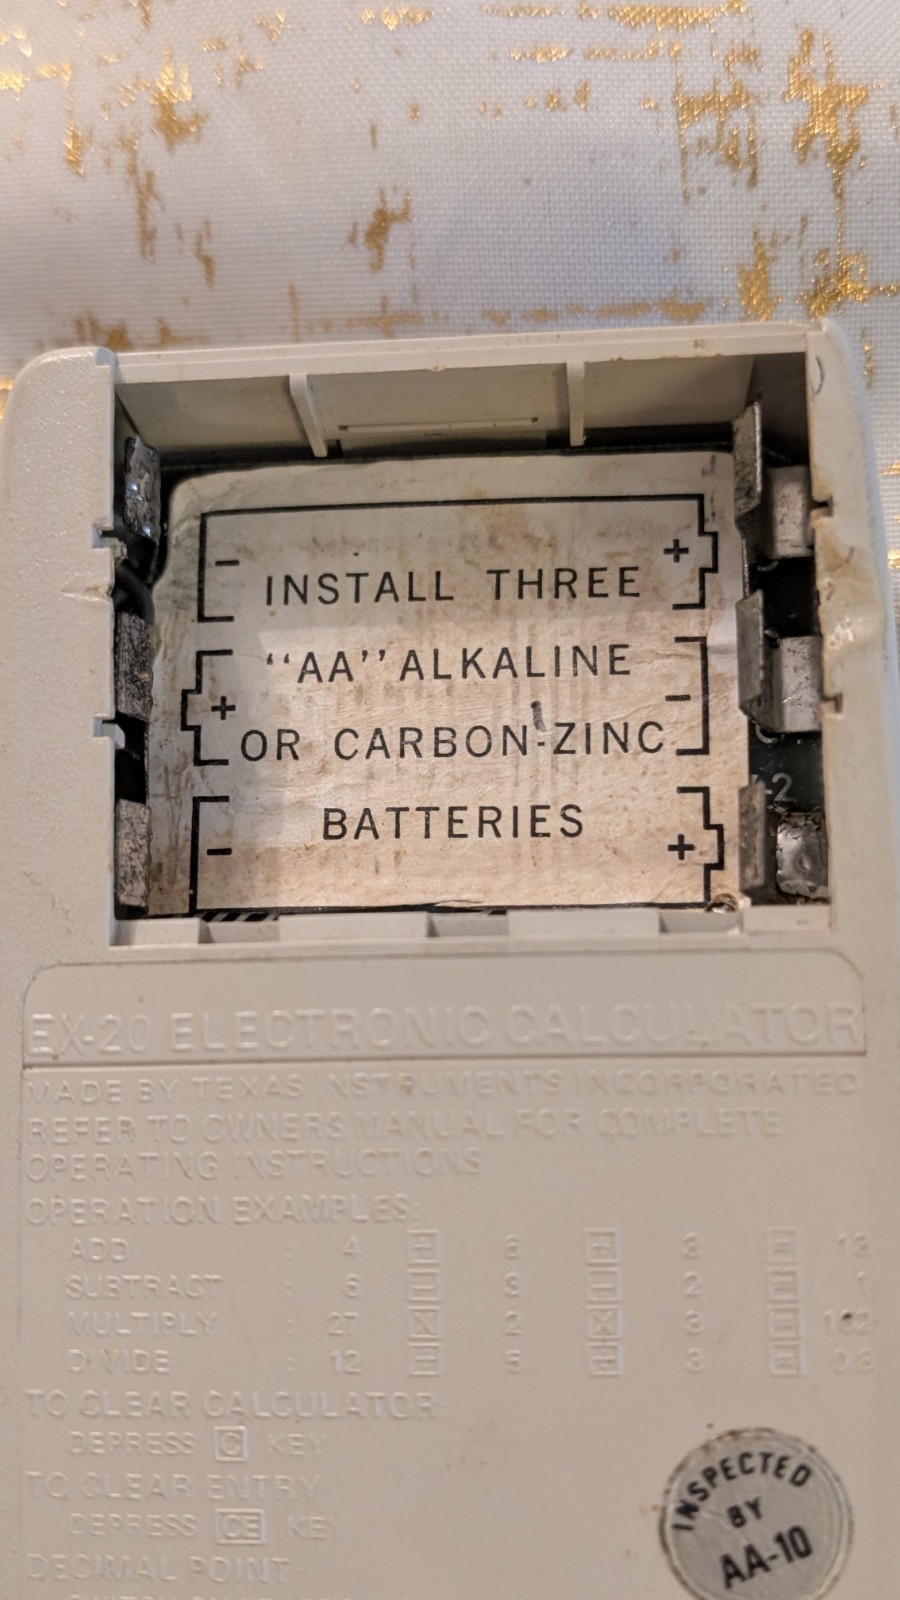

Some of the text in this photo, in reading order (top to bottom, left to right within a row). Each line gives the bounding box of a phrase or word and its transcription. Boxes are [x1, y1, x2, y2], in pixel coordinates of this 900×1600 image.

[266, 566, 641, 606] INSTALL THREE
[400, 644, 631, 681] ALKALINE
[240, 721, 665, 761] OR CARBON-ZINC
[322, 804, 583, 841] BATTERIES
[27, 1001, 860, 1056] EX-20 ELECTRONIC CALCULATOR
[27, 1069, 858, 1104] MADE BY TEXAS INSTRUMENTS INCORPORATED
[28, 1106, 782, 1145] REFER TO OWNERS MANUAL FOR COMPLETE
[25, 1146, 485, 1183] OPERATING INSTRUCTIONS
[25, 1196, 220, 1225] OPERATION
[67, 1236, 130, 1263] ADD
[342, 1234, 362, 1260] 4
[65, 1273, 223, 1301] SUBTRACT
[343, 1272, 362, 1299] 6
[683, 1270, 701, 1298] 2
[67, 1311, 219, 1338] MULTIPLY
[325, 1311, 362, 1337] 27
[503, 1310, 524, 1337] 2
[67, 1348, 172, 1375] DIVIDE
[329, 1348, 362, 1375] 12
[25, 1389, 437, 1421] TO CLEAR CALCULATOR
[68, 1430, 197, 1457] DEPRESS
[267, 1432, 328, 1457] KEY
[25, 1471, 321, 1501] TO CLEAR ENTRY
[672, 1451, 812, 1532] INSPECTED
[68, 1512, 198, 1539] DEPRESS
[287, 1514, 347, 1541] KEY
[726, 1497, 763, 1530] BY
[25, 1553, 178, 1584] DECIMAL
[719, 1524, 813, 1589] AA-10
